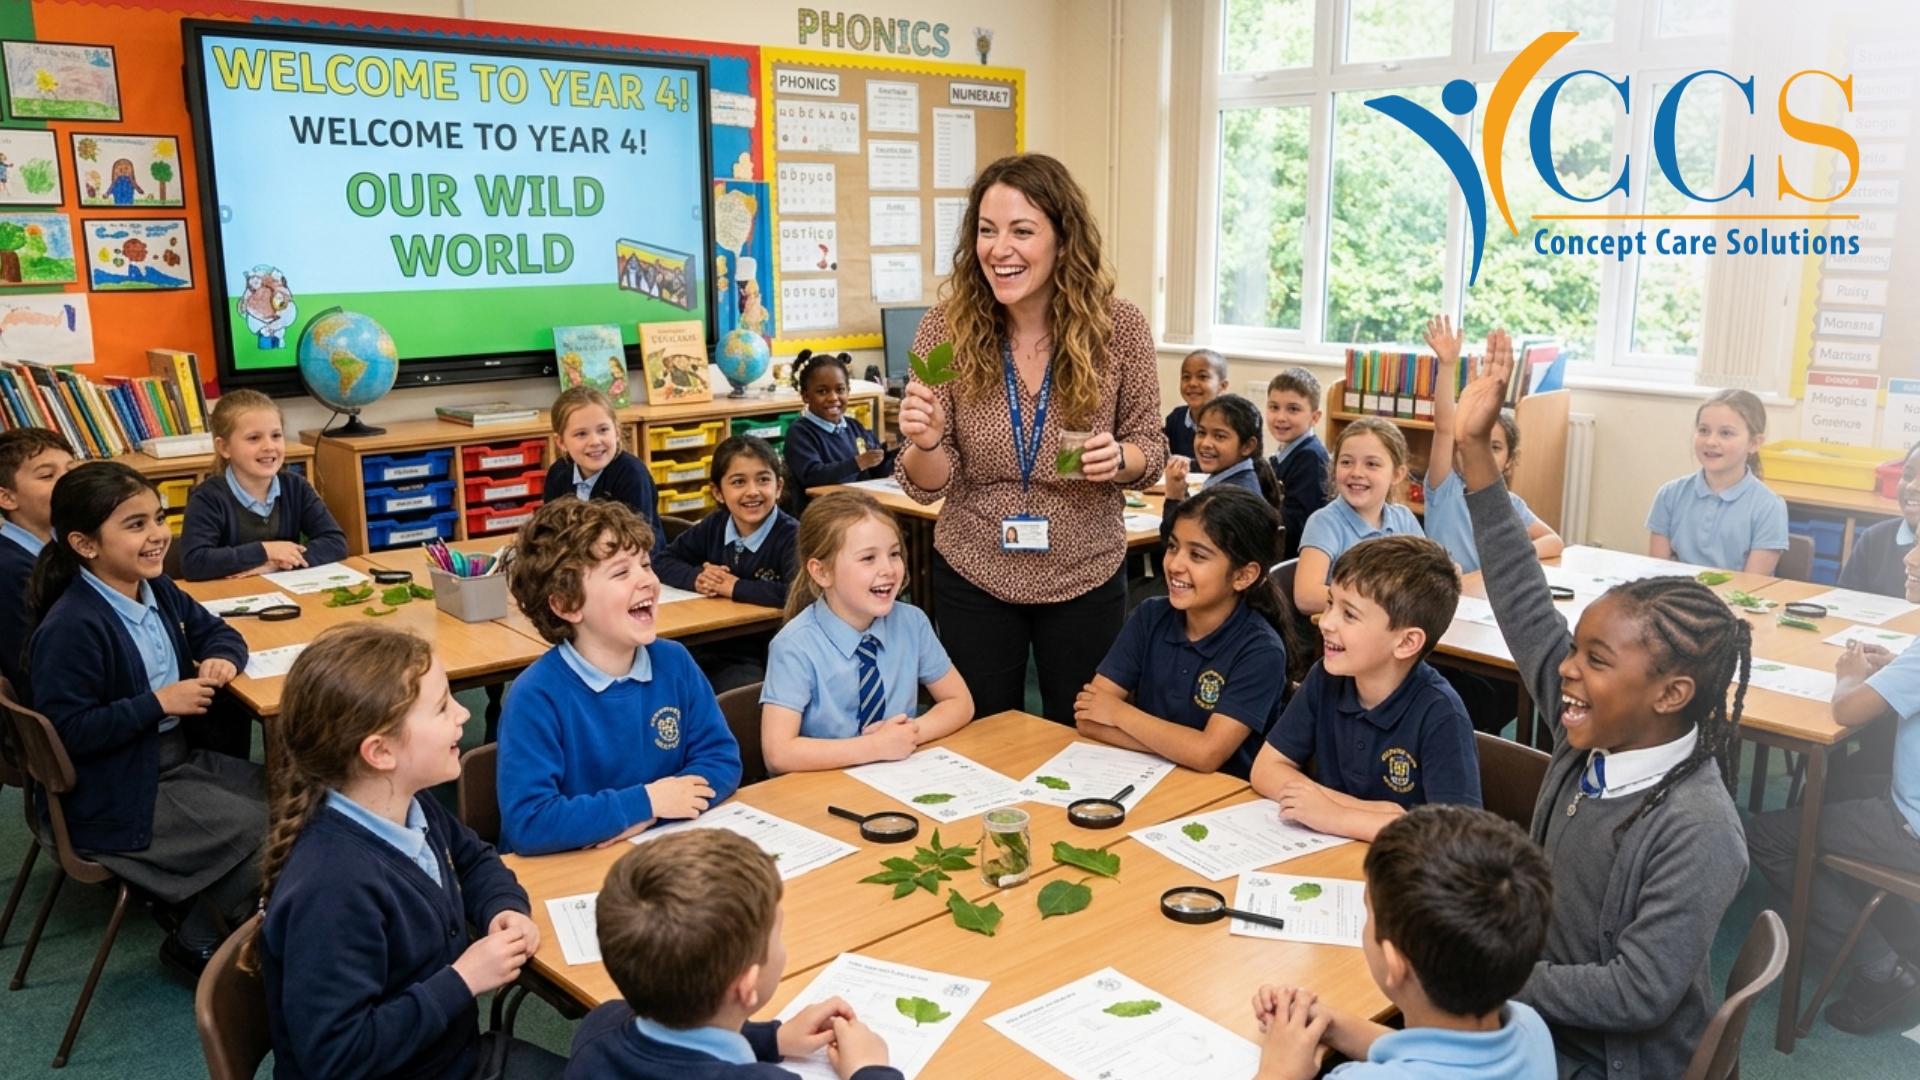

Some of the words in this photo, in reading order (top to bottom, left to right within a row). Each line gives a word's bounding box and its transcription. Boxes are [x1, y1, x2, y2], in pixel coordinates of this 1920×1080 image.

[797, 8, 950, 58] PHONICS
[1858, 47, 1920, 63] Student
[212, 45, 457, 100] WELCOME
[470, 63, 528, 104] TO
[540, 68, 644, 110] YEAR
[655, 76, 690, 113] 4!
[779, 75, 837, 92] PHONICS
[290, 115, 462, 150] WELCOME
[474, 123, 517, 152] TO
[527, 124, 611, 154] YEAR
[620, 129, 648, 155] 4!
[346, 172, 461, 218] OUR
[475, 174, 605, 218] WILD
[391, 234, 574, 278] WORLD
